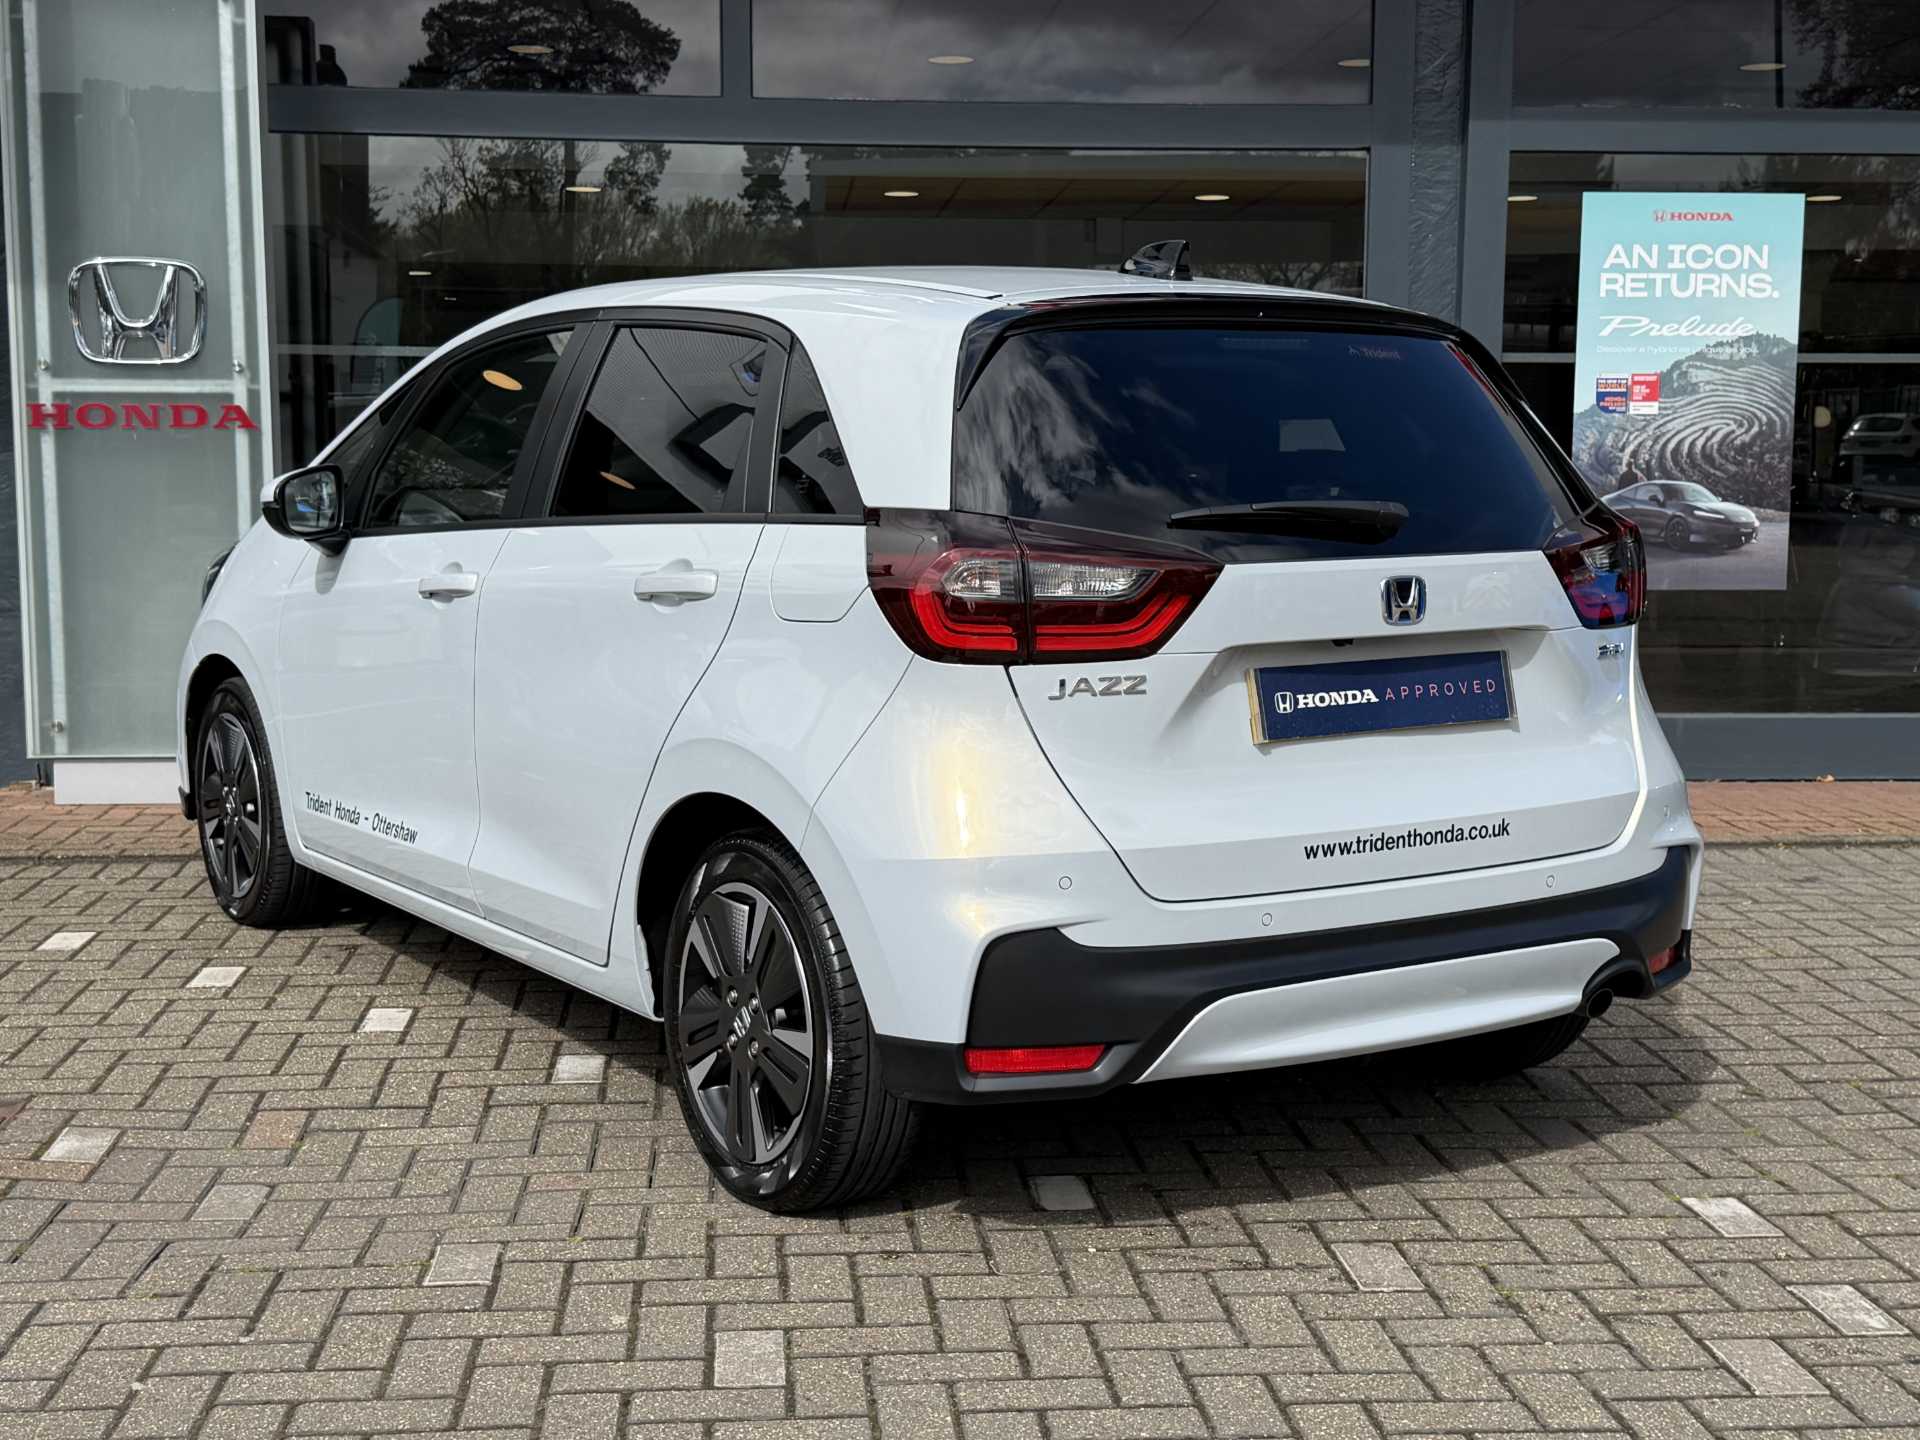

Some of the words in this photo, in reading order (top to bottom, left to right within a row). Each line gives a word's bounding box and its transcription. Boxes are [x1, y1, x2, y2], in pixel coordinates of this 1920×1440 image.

[1669, 211, 1734, 222] HONDA
[1603, 243, 1658, 270] AN
[1667, 243, 1769, 270] ICON
[1600, 272, 1780, 299] RETURNS.
[1598, 314, 1756, 337] Prelude
[26, 403, 258, 431] HONDA
[1047, 675, 1147, 701] JAZZ
[1296, 688, 1380, 709] HONDA
[1385, 679, 1497, 701] APPROVED
[305, 791, 332, 816] Trident
[335, 799, 360, 825] Honda
[372, 812, 418, 844] Ottershaw
[1304, 818, 1511, 860] www.tridenthonda.co.uk
